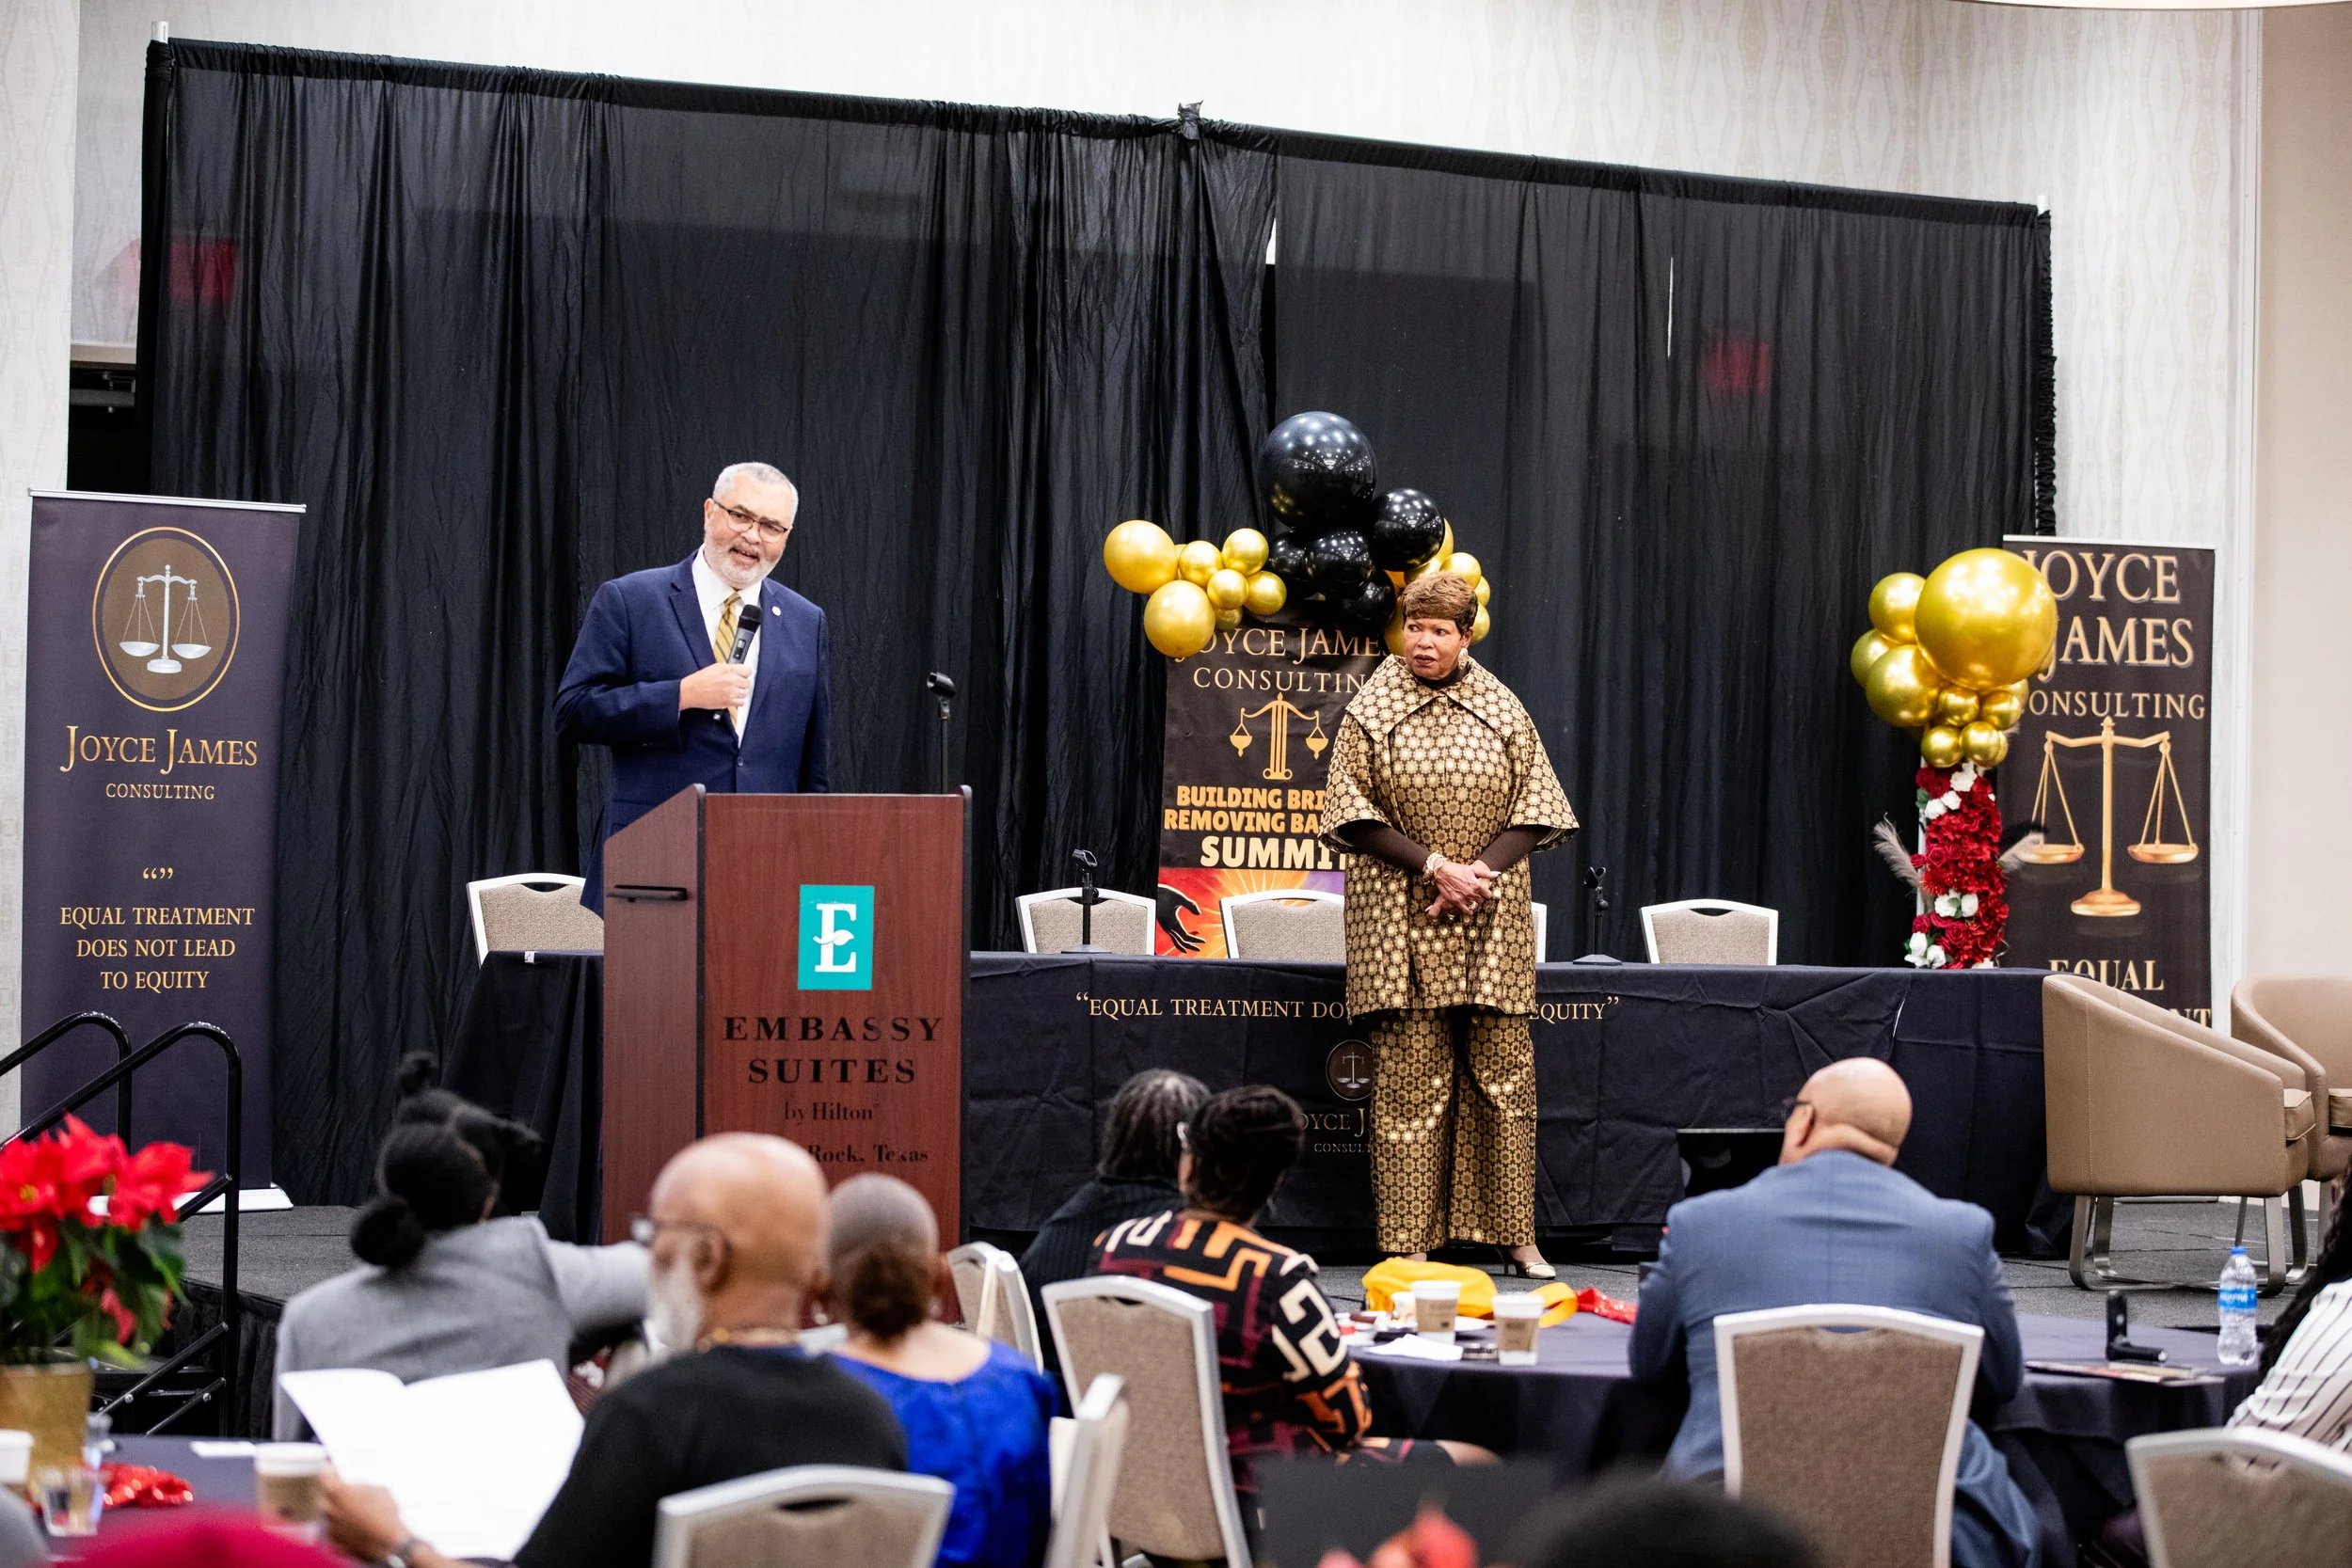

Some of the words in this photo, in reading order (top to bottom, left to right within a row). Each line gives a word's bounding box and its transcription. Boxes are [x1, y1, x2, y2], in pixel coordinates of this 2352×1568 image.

[1175, 627, 1287, 663] OYCE
[1293, 627, 1390, 665] JAME
[1193, 667, 1366, 693] CONSULTIN
[2028, 689, 2206, 721] ONSULTING
[59, 725, 156, 772] JOYCE
[159, 728, 258, 775] JAMES
[105, 783, 215, 800] CONSULTING
[1176, 785, 1283, 810] BUILDING
[1287, 788, 1326, 811] BRI
[1164, 809, 1286, 832] REMOVING
[1290, 813, 1319, 834] BA
[59, 907, 126, 930] EQUAL
[132, 907, 256, 926] TREATMENT
[76, 939, 128, 958] DOES
[135, 939, 178, 958] NOT
[183, 939, 236, 958] LEAD
[100, 971, 128, 990] TO
[135, 971, 210, 993] EQUITY
[1170, 998, 1305, 1019] TREATMENT
[1311, 1001, 1345, 1019] DO
[723, 1015, 944, 1042] EMBASSY
[748, 1058, 916, 1084] SUITES
[784, 1101, 804, 1126] by
[1300, 1113, 1350, 1131] OYCE
[872, 1144, 929, 1163] Texas
[1313, 1142, 1371, 1153] CONSULT
